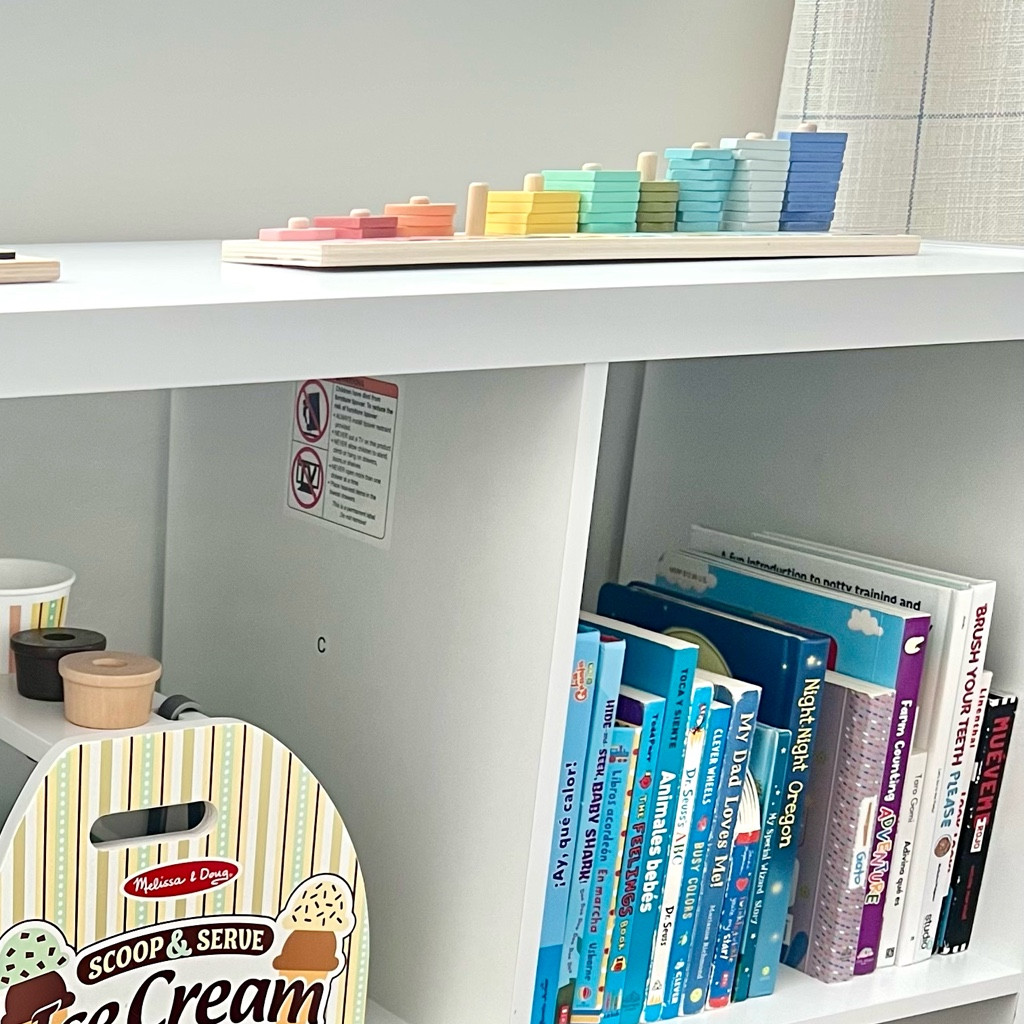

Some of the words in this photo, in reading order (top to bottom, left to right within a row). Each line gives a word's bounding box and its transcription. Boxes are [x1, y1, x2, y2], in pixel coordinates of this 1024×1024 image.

[900, 599, 922, 610] and
[968, 603, 988, 663] BRUSH
[677, 668, 689, 697] TOCA
[960, 669, 976, 716] YOUR
[603, 700, 616, 728] HIDE
[669, 708, 682, 749] SIENTE
[736, 712, 754, 743] My
[895, 700, 913, 737] Farm
[709, 729, 723, 765] CLEVER
[951, 717, 969, 766] TEETH
[562, 761, 577, 812] calor!
[610, 769, 622, 804] Libros
[685, 768, 697, 785] Dr.
[702, 767, 717, 805] WHEELS
[728, 750, 747, 788] Dad
[884, 741, 905, 802] Counting
[912, 774, 923, 796] Taro
[589, 781, 604, 823] BABY
[637, 795, 647, 819] THE
[649, 771, 677, 856] Animales
[677, 789, 693, 827] Seuss's
[779, 781, 803, 849] Oregon
[908, 798, 918, 823] Gomi
[941, 770, 961, 828] PLEASE
[557, 818, 571, 849] qué
[600, 808, 614, 862] acordeón
[717, 795, 739, 849] Loves
[766, 813, 777, 826] My
[973, 824, 984, 850] ROJO
[578, 828, 596, 885] SHARK!
[691, 842, 705, 873] BUSY
[762, 828, 774, 861] Special
[865, 806, 895, 905] ADVENTURE
[899, 841, 911, 875] Adivina
[133, 876, 186, 894] Melissa
[199, 868, 229, 885] Doug
[552, 852, 571, 888] ¡Ay,
[595, 869, 608, 884] En
[618, 822, 646, 918] FEELINGS
[640, 858, 663, 914] bebés
[710, 856, 729, 889] Me!
[756, 862, 769, 894] Wizard
[853, 851, 867, 885] Gato
[682, 877, 698, 920] COLORS
[895, 878, 905, 896] qué
[588, 886, 603, 933] marcha
[665, 905, 674, 920] Dr.
[750, 898, 763, 924] Story
[660, 921, 672, 947] Seuss
[88, 937, 164, 980] SCOOP
[166, 929, 192, 959] &
[197, 926, 265, 954] SERVE
[584, 943, 597, 982] Usborne
